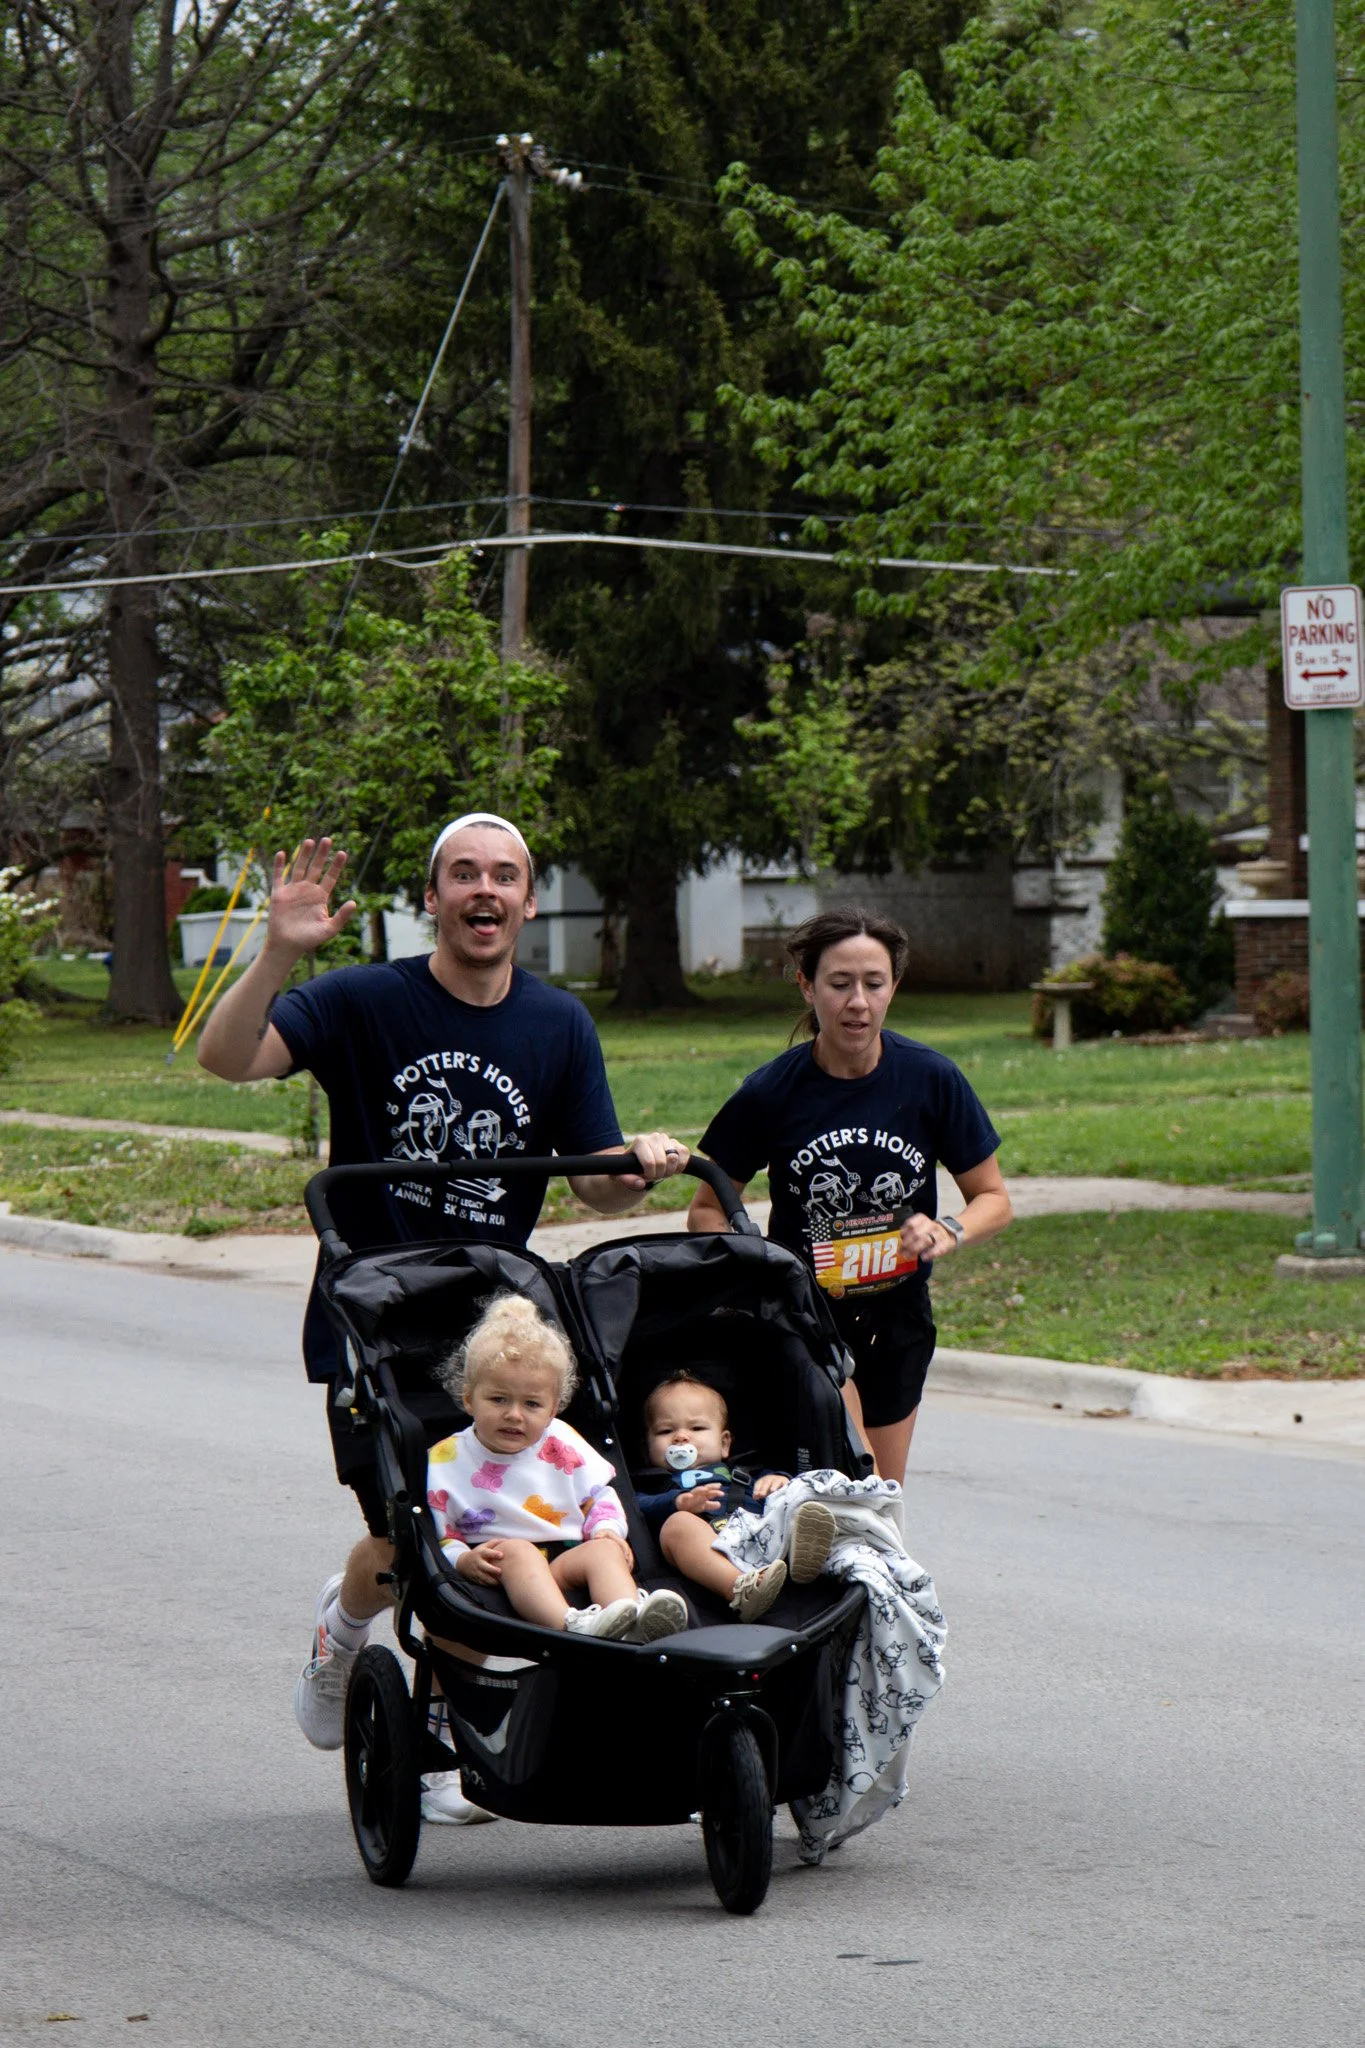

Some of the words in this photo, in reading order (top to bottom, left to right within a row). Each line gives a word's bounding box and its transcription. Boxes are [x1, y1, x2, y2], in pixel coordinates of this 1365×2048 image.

[1307, 598, 1334, 620] NO
[1289, 623, 1355, 646] PARKING
[392, 1051, 481, 1093] POTTER'S
[483, 1063, 531, 1128] HOUSE
[790, 1127, 869, 1176] POTTER'S
[873, 1129, 926, 1173] HOUSE
[788, 1183, 801, 1195] 20
[395, 1187, 432, 1208] ANNU
[443, 1203, 457, 1216] 5K
[459, 1209, 468, 1219] &
[469, 1210, 487, 1223] FUN
[460, 1198, 485, 1210] LEGACY
[842, 1237, 899, 1280] 2112
